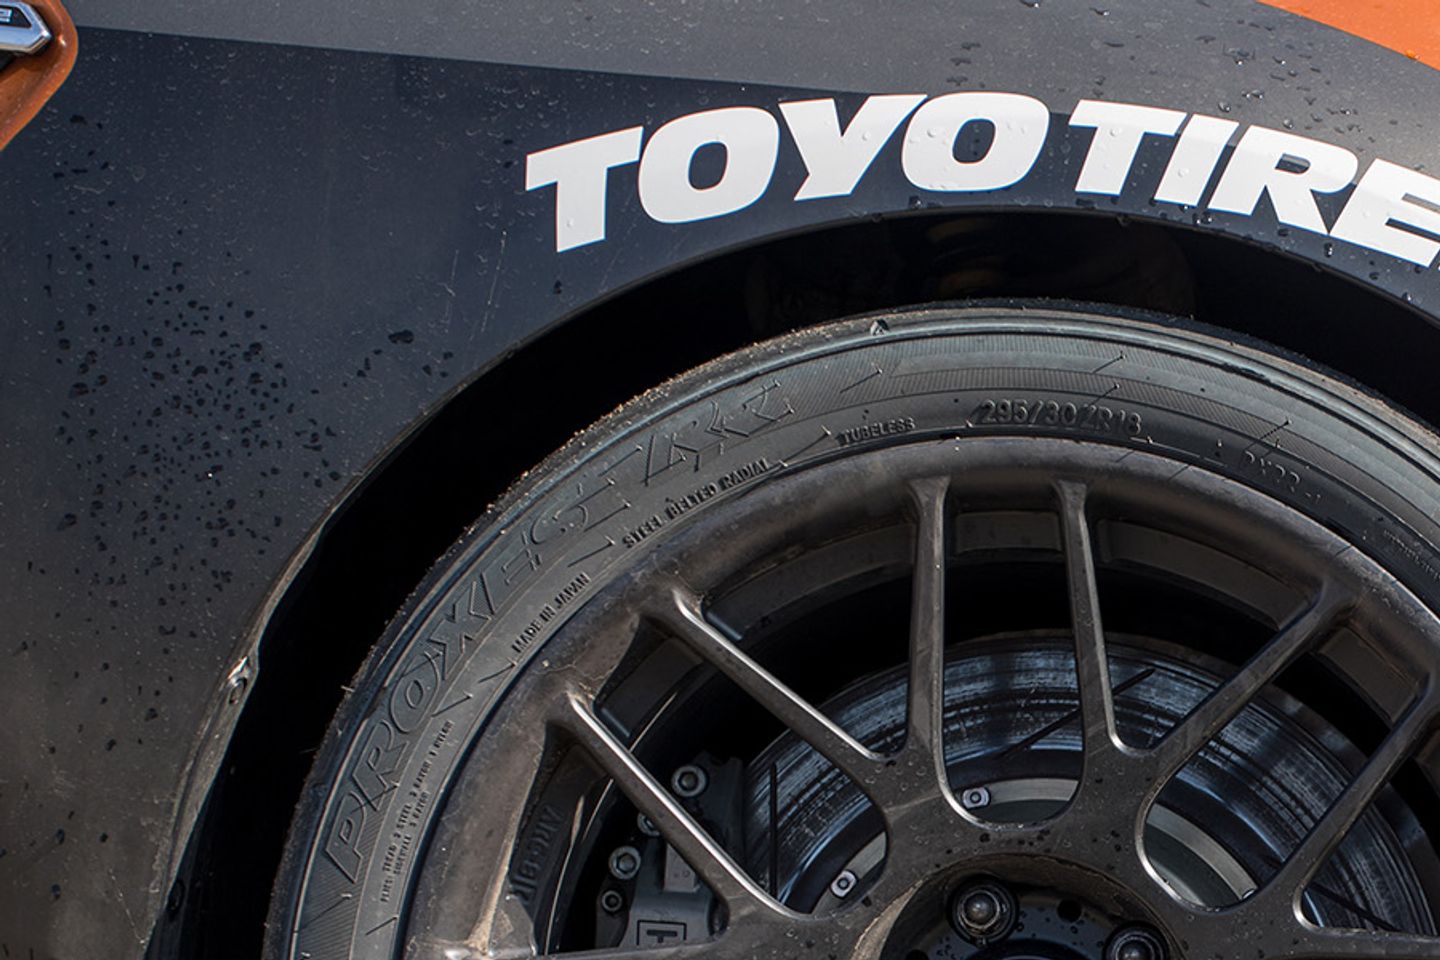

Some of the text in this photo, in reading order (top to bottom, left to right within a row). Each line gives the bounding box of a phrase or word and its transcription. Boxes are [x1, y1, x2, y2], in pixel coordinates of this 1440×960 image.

[524, 91, 1051, 252] TOYO
[842, 416, 915, 444] TUBELESS
[621, 455, 771, 549] STEEL BELTED RADIAL
[510, 569, 591, 654] MADE IN JAPAN
[324, 484, 590, 883] PROXES
